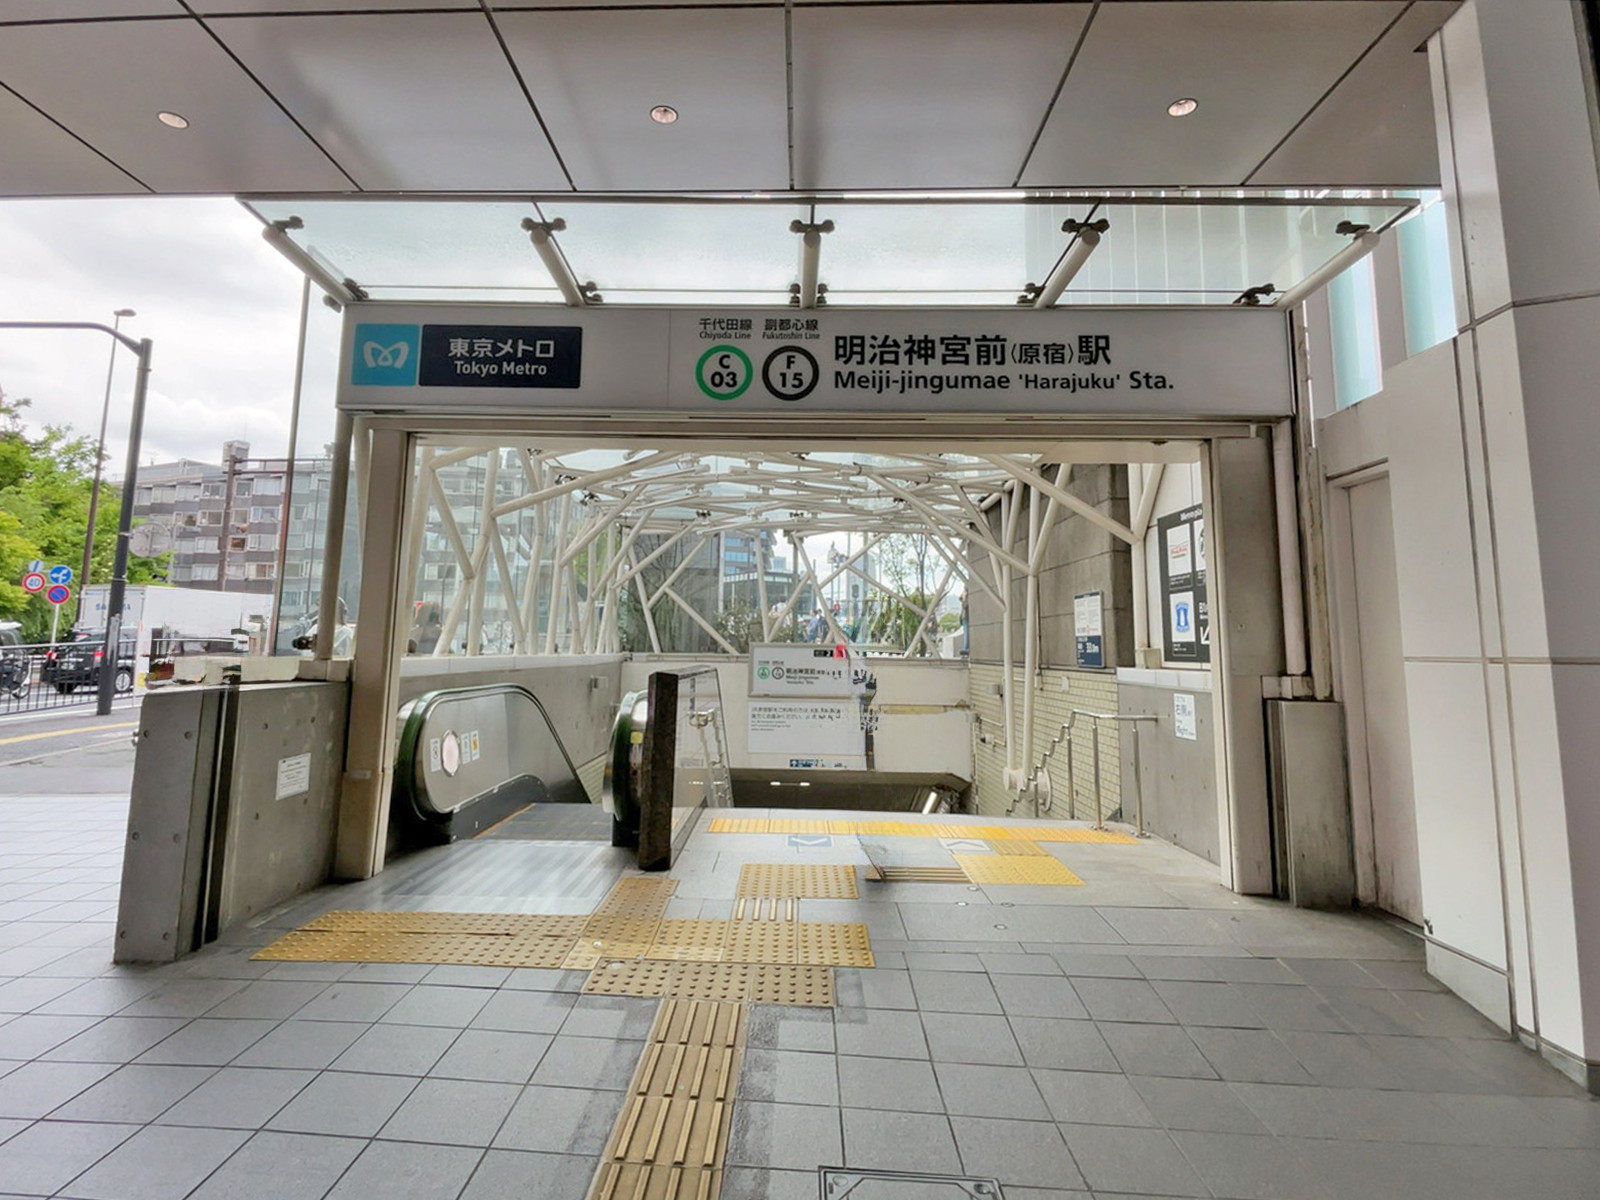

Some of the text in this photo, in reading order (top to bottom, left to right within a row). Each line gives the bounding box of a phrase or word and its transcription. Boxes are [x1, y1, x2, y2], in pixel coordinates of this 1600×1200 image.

[699, 318, 753, 331] 千代田線
[764, 318, 819, 331] 副都心線
[699, 331, 752, 341] Chiyoda Line
[762, 331, 820, 340] Fukutoshin Line
[449, 338, 555, 358] 東京メトロ
[454, 361, 547, 377] Tokyo Metro
[718, 354, 731, 369] C
[786, 354, 796, 369] F
[711, 371, 738, 388] 03
[780, 372, 804, 388] 15
[834, 370, 1175, 395] Meiji-jingumae 'Harajuku' Sta.
[28, 578, 41, 587] 40
